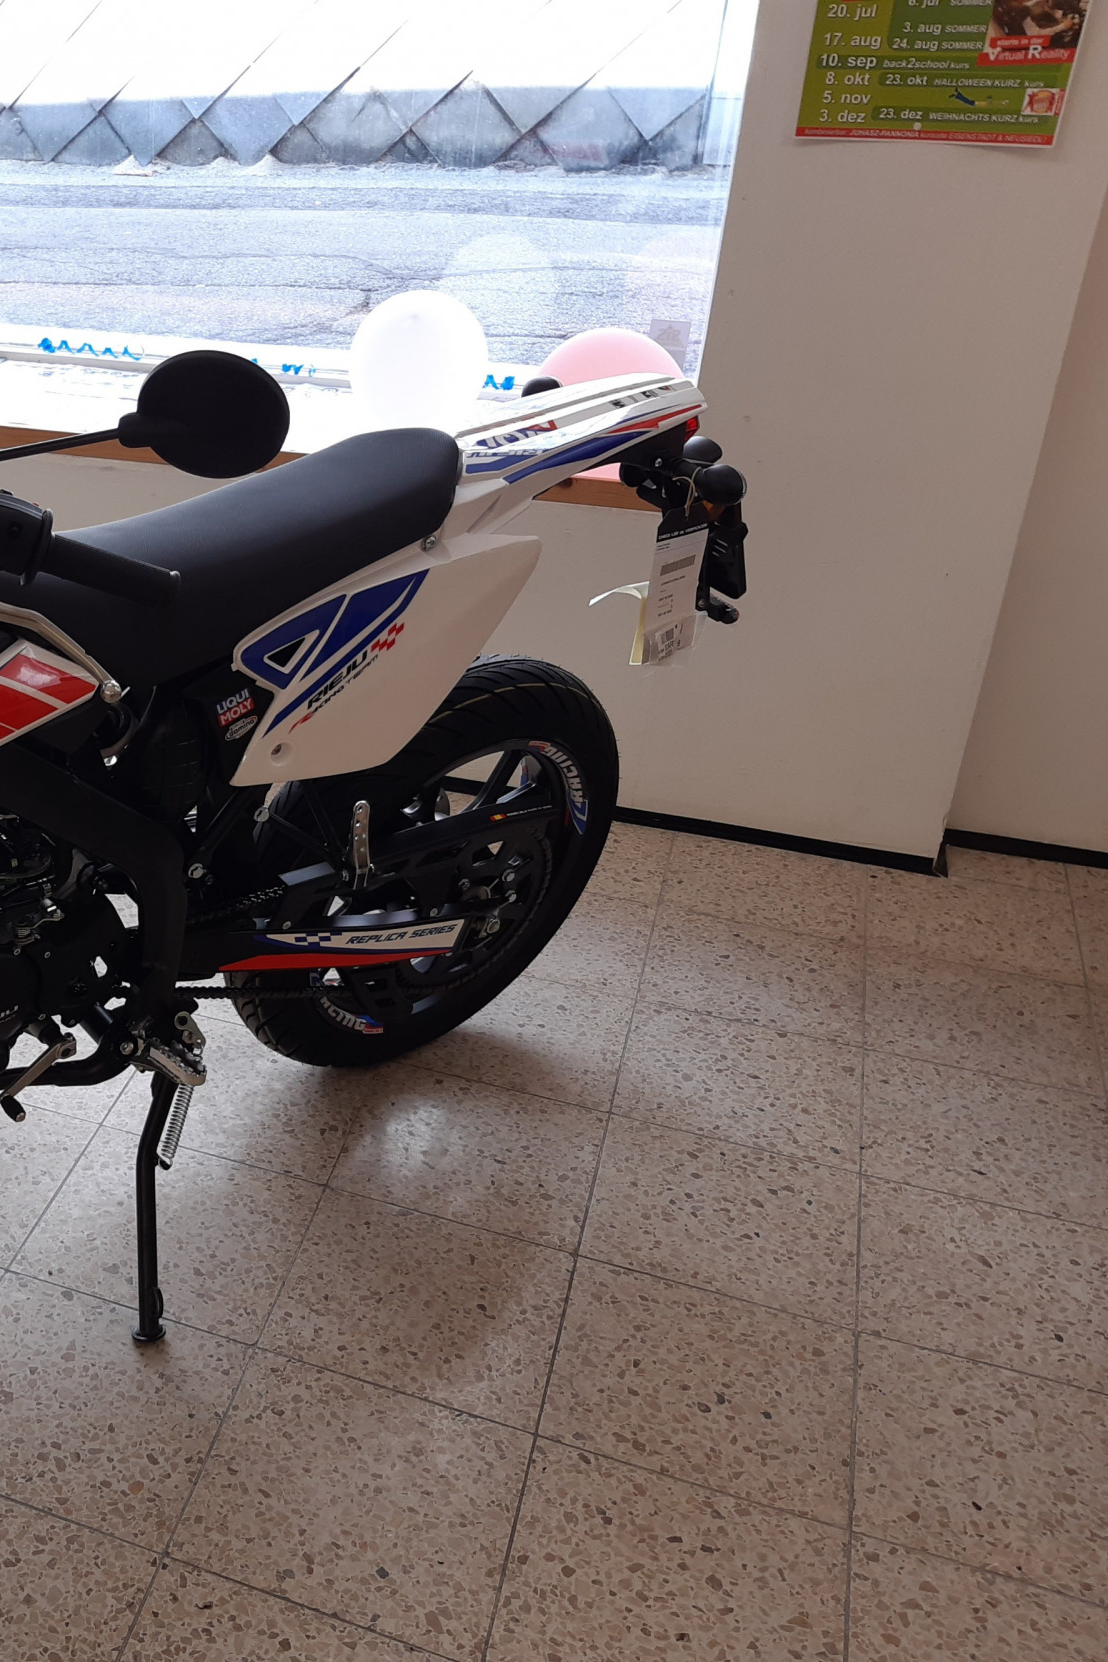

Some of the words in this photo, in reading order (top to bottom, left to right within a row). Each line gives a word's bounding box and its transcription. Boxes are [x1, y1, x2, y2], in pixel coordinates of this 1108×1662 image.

[828, 4, 851, 18] 20.
[854, 4, 877, 20] jul
[903, 22, 914, 33] 3.
[917, 23, 942, 35] aug
[945, 24, 987, 33] SOMMER
[824, 32, 846, 46] 17.
[850, 35, 882, 49] aug
[892, 38, 910, 49] 24.
[914, 40, 939, 52] aug
[941, 41, 984, 49] SOMMER
[987, 46, 1026, 61] Virtual
[1028, 44, 1070, 60] Reality
[820, 53, 842, 67] 10.
[847, 56, 877, 70] sep
[883, 58, 949, 69] back2school
[949, 61, 970, 69] kurs
[825, 72, 839, 85] 8.
[844, 72, 871, 86] okt
[885, 74, 903, 85] 23.
[907, 75, 928, 86] okt
[934, 78, 993, 87] HALLOWEEN
[994, 79, 1021, 88] KURZ
[822, 91, 835, 104] 5.
[840, 93, 871, 104] nov
[819, 109, 832, 122] 3.
[837, 110, 866, 123] dez
[879, 108, 897, 119] 23.
[900, 109, 924, 120] dez
[929, 112, 990, 122] WEIHNACHTS
[992, 114, 1017, 123] KURZ
[307, 649, 368, 711] RIEJU
[216, 688, 250, 715] LIQUI
[220, 697, 253, 725] MOLY
[229, 718, 255, 738] domino
[345, 931, 408, 945] REPLICA
[408, 924, 459, 939] SERIES
[319, 995, 367, 1031] ACING
